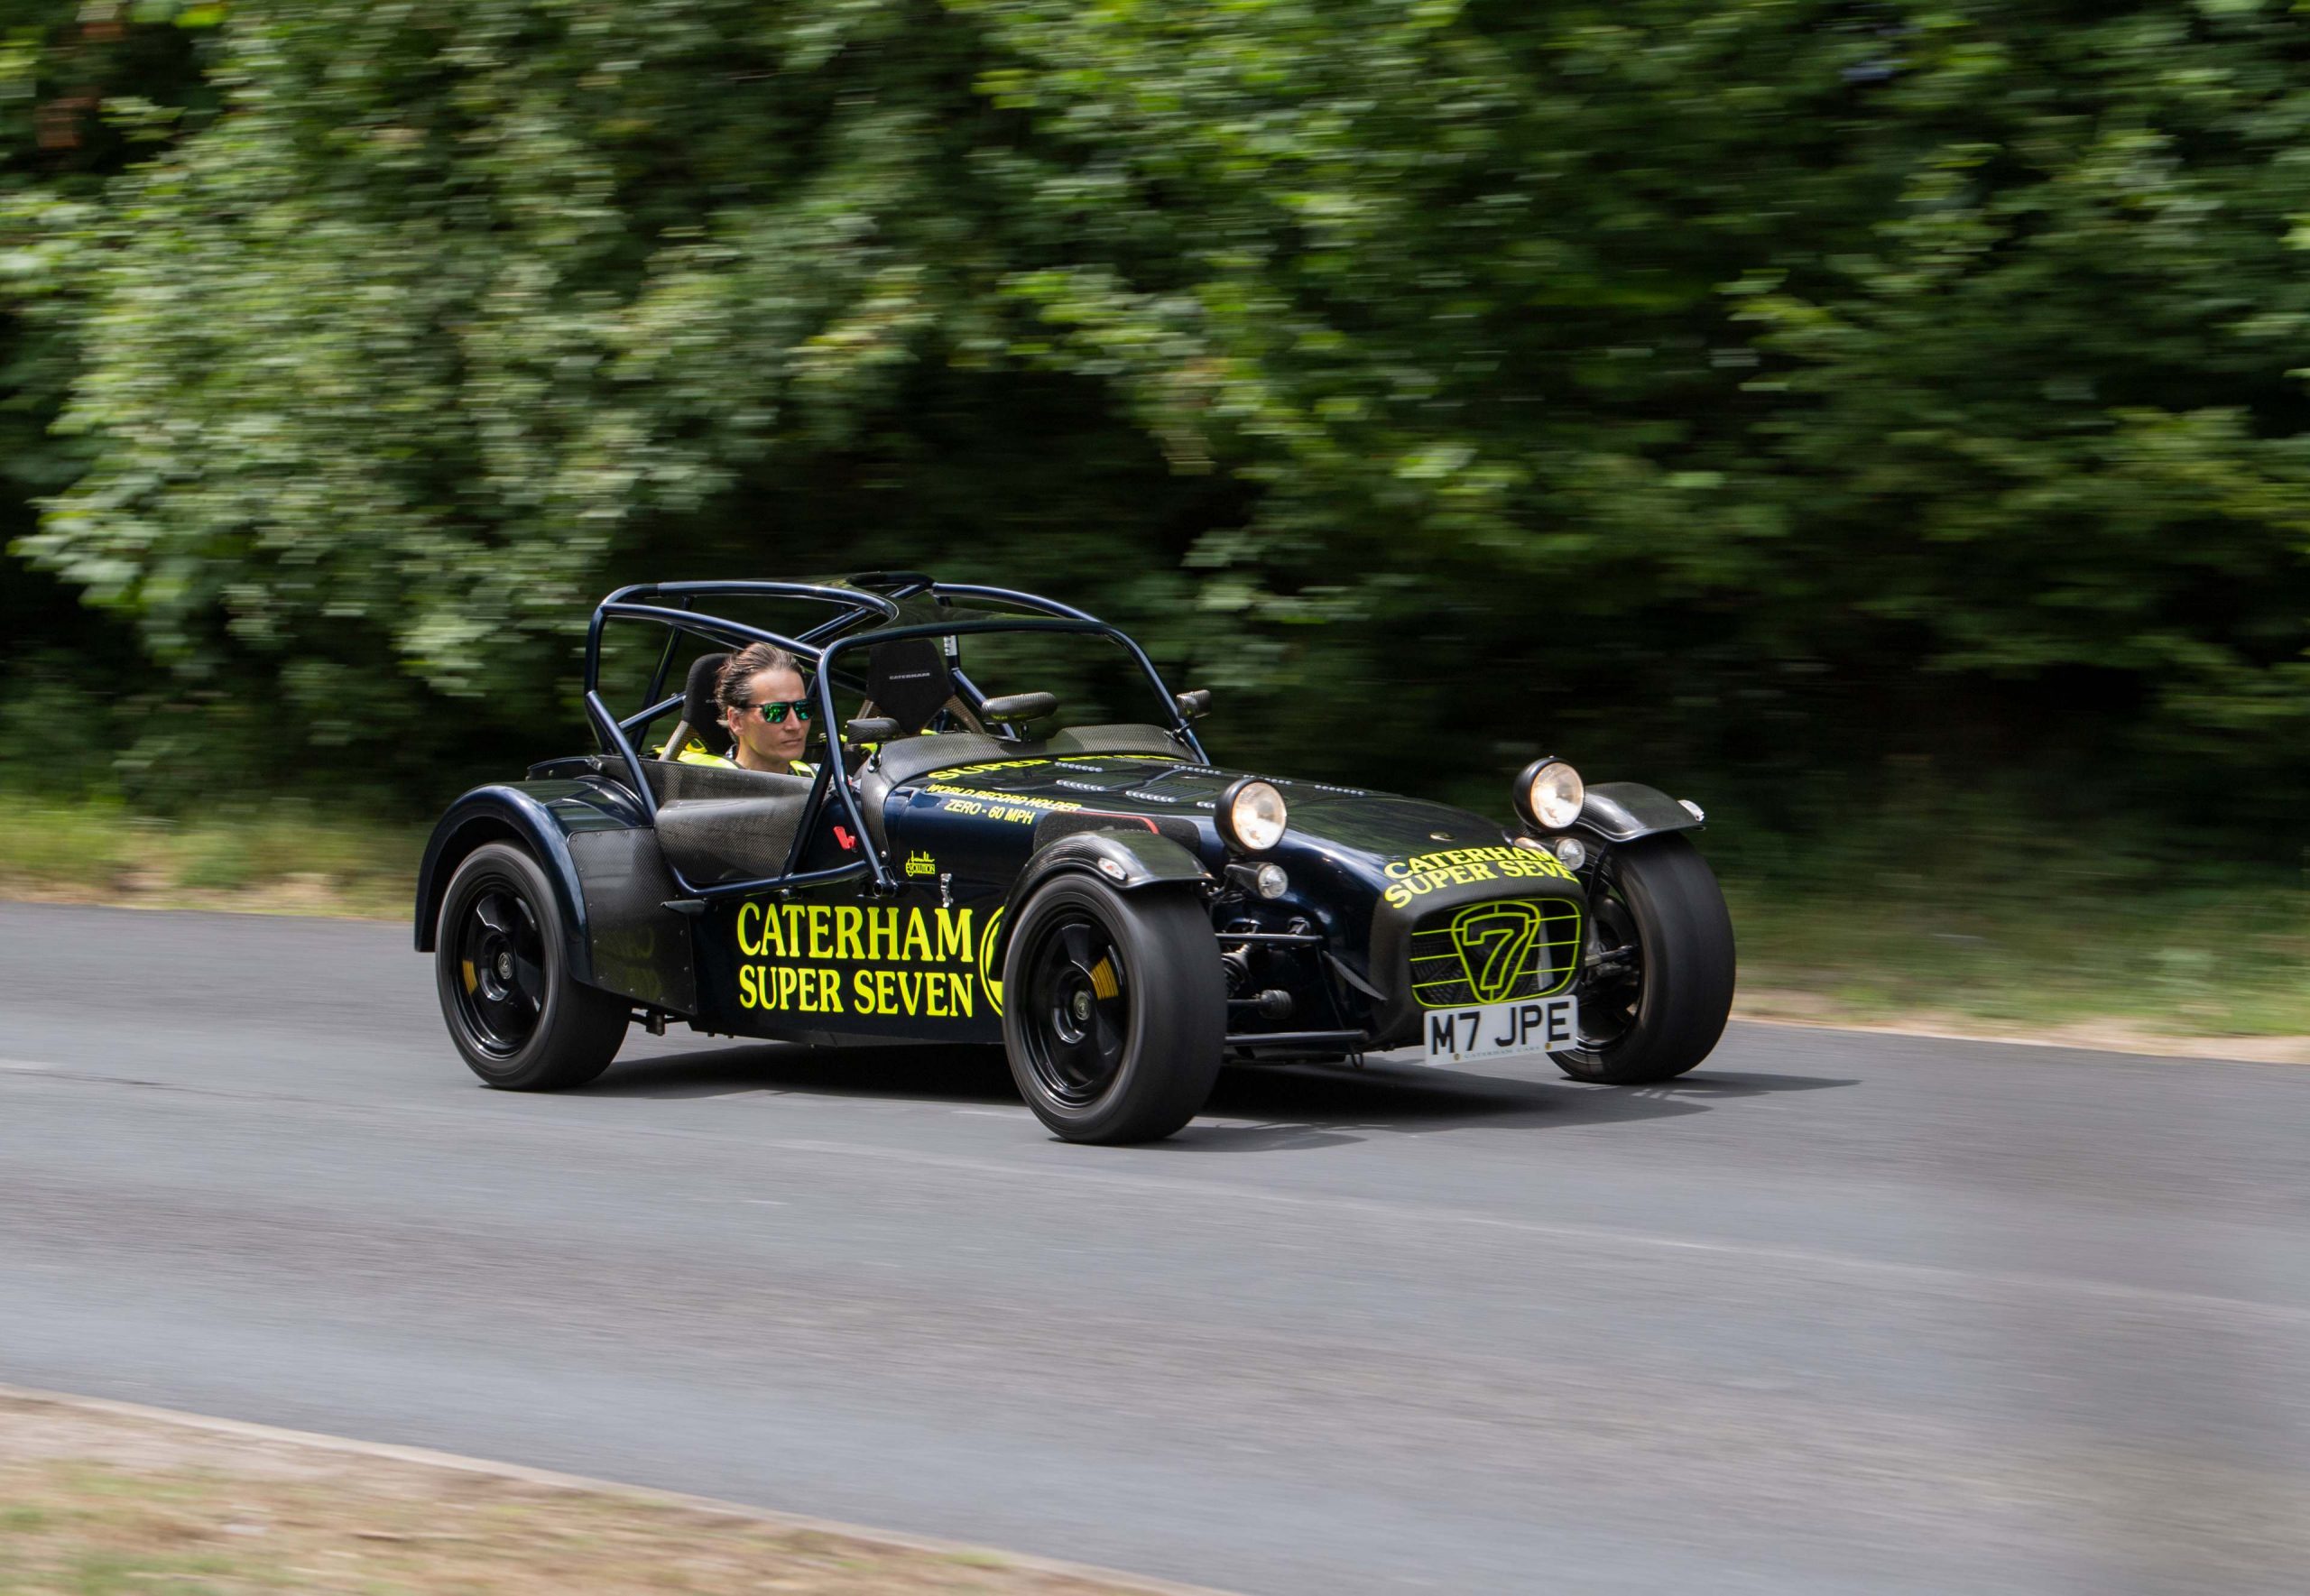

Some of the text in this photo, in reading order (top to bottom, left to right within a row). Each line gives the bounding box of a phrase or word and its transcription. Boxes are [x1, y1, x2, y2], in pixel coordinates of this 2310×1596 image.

[928, 759, 1052, 780] SUPER
[926, 784, 1082, 811] WORLD RECORD HOLDER
[944, 799, 982, 815] ZERO
[988, 806, 1004, 819] 60
[1004, 809, 1036, 825] MPH
[1384, 846, 1563, 880] CATERHAM
[1384, 860, 1580, 909] SUPER SEVE
[737, 901, 974, 963] CATERHAM
[1463, 912, 1529, 990] 7
[739, 964, 973, 1018] SUPER SEVEN
[1431, 1001, 1570, 1055] M7 JPE
[1465, 1047, 1513, 1059] CATERHAM
